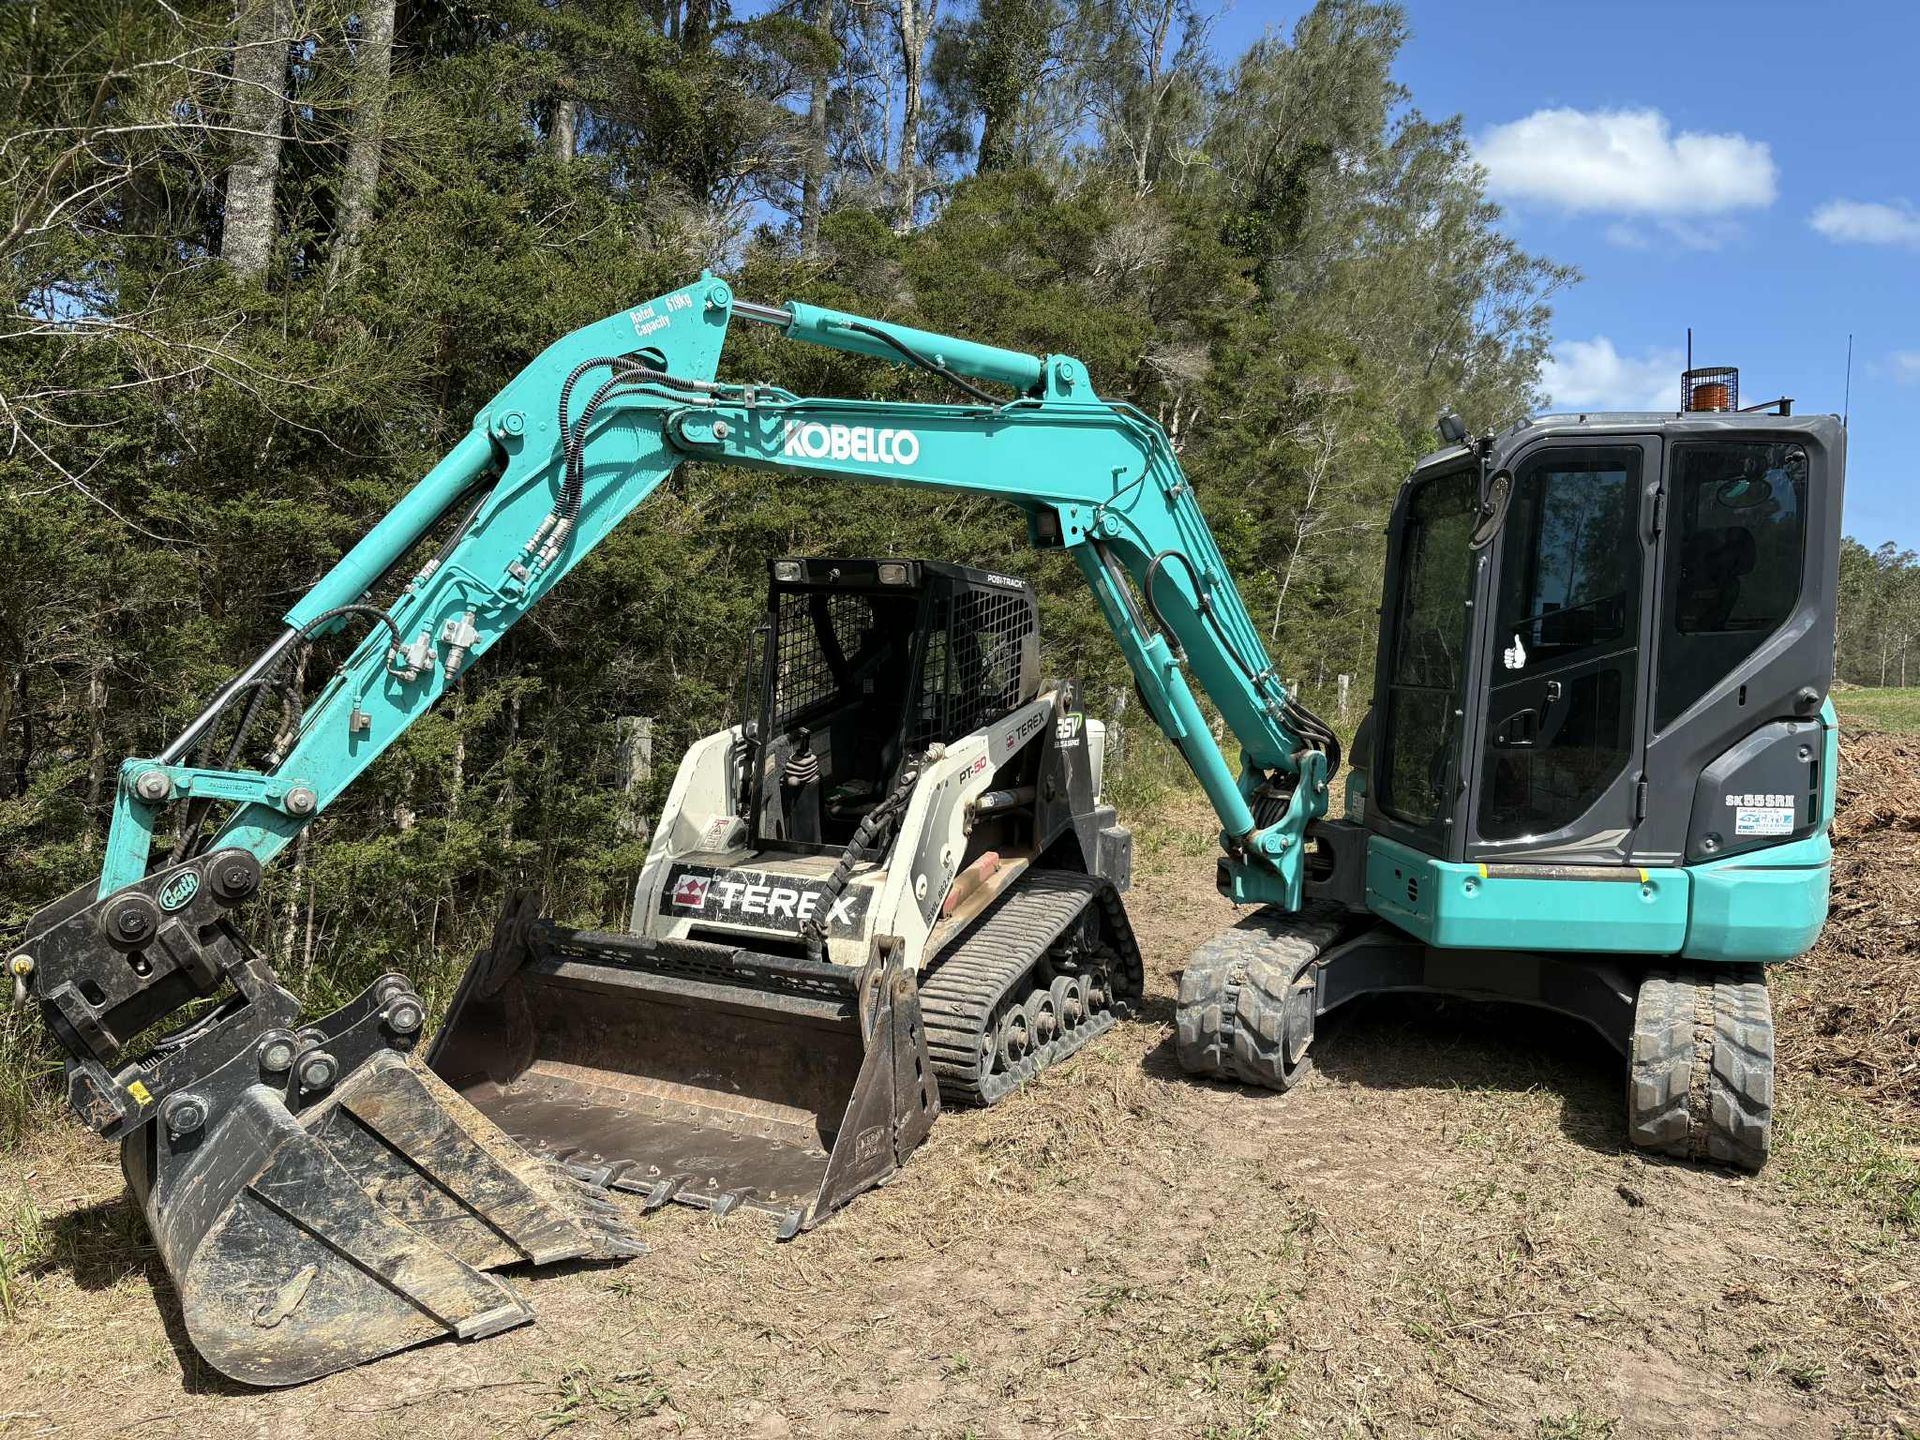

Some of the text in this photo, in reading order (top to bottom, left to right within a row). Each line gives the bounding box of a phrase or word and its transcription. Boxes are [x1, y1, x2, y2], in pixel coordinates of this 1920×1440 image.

[630, 305, 655, 324] Rated
[634, 315, 671, 336] Capacity
[784, 419, 920, 465] KOBELCO
[1016, 710, 1044, 740] TEREX
[959, 755, 986, 785] PT-50
[717, 880, 857, 926] TEREX
